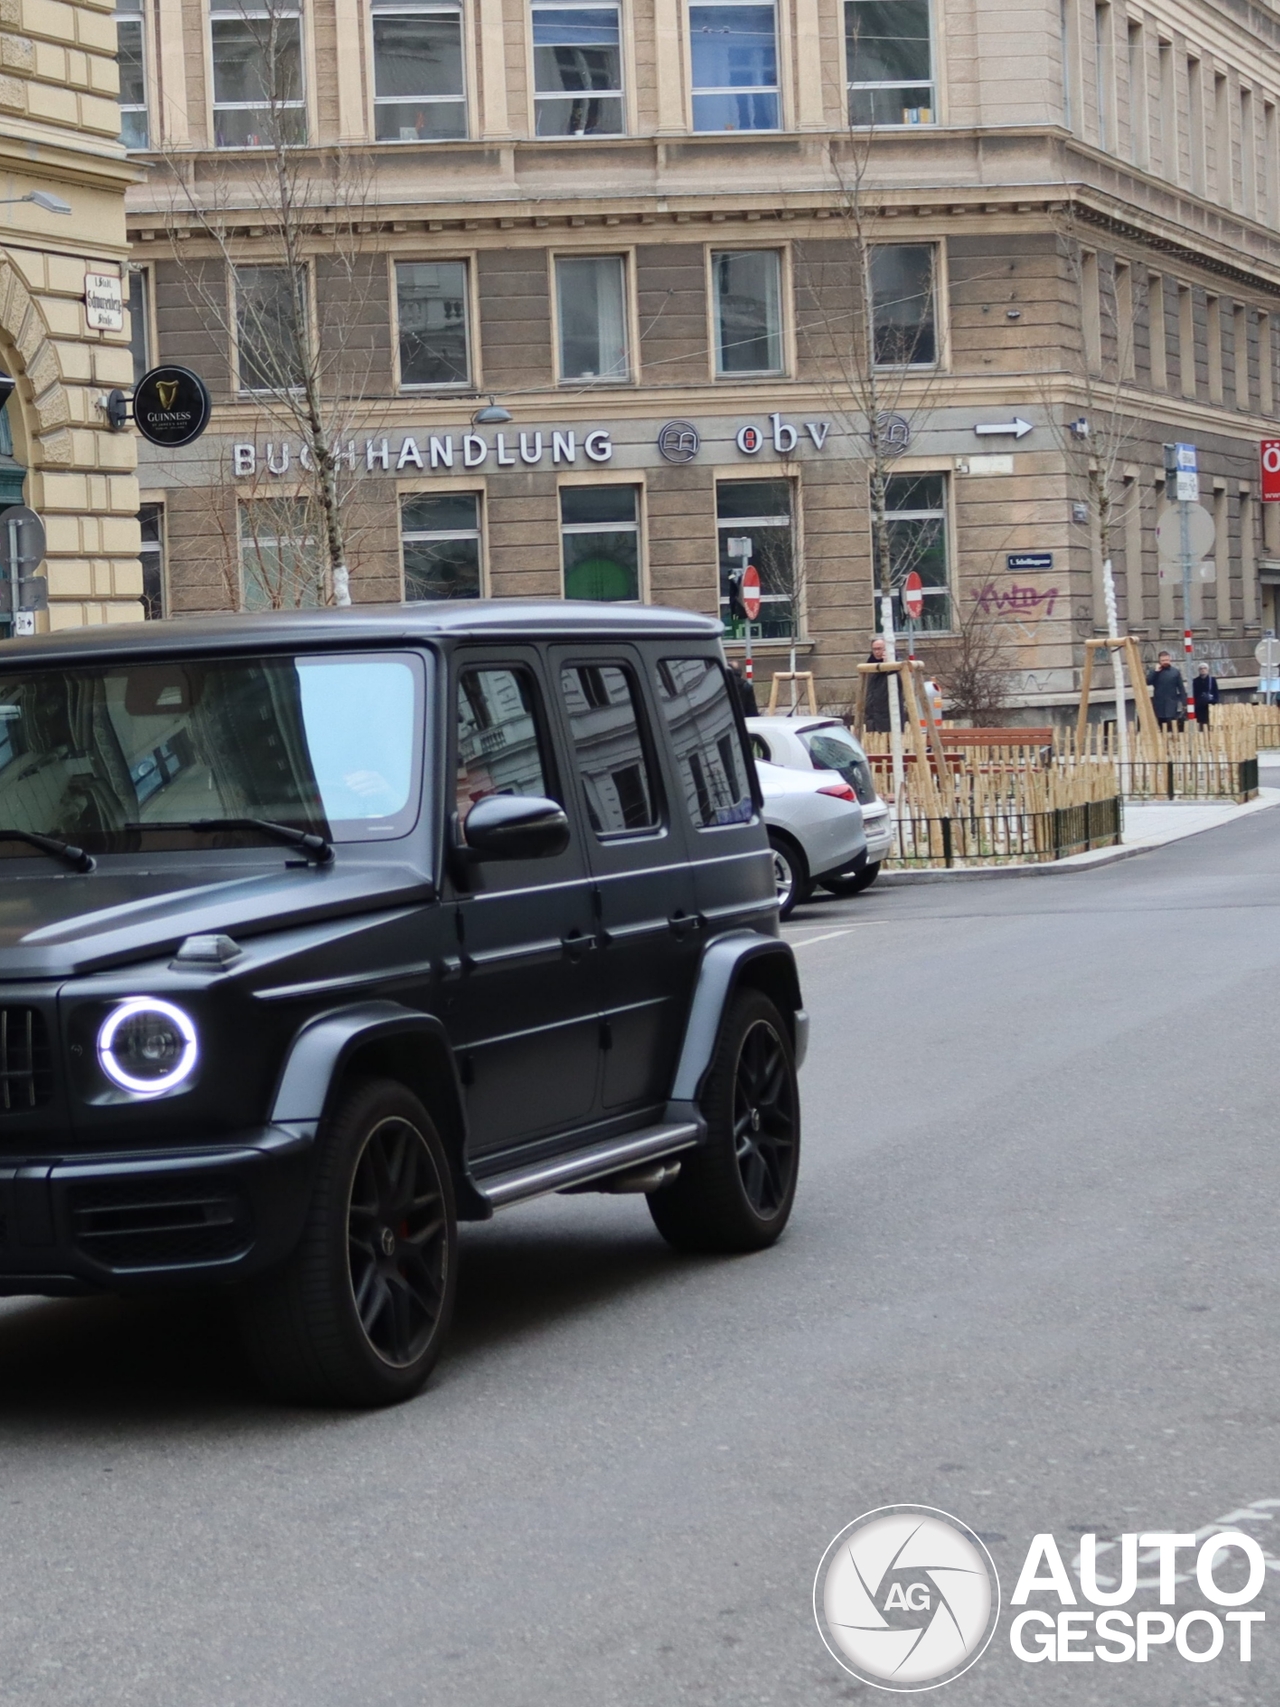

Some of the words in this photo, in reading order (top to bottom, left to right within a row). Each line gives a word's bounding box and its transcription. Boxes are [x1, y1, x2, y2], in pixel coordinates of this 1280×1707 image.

[147, 411, 192, 422] GUINNESS
[735, 412, 830, 454] obv
[233, 429, 613, 477] BUCHHANDLUNG
